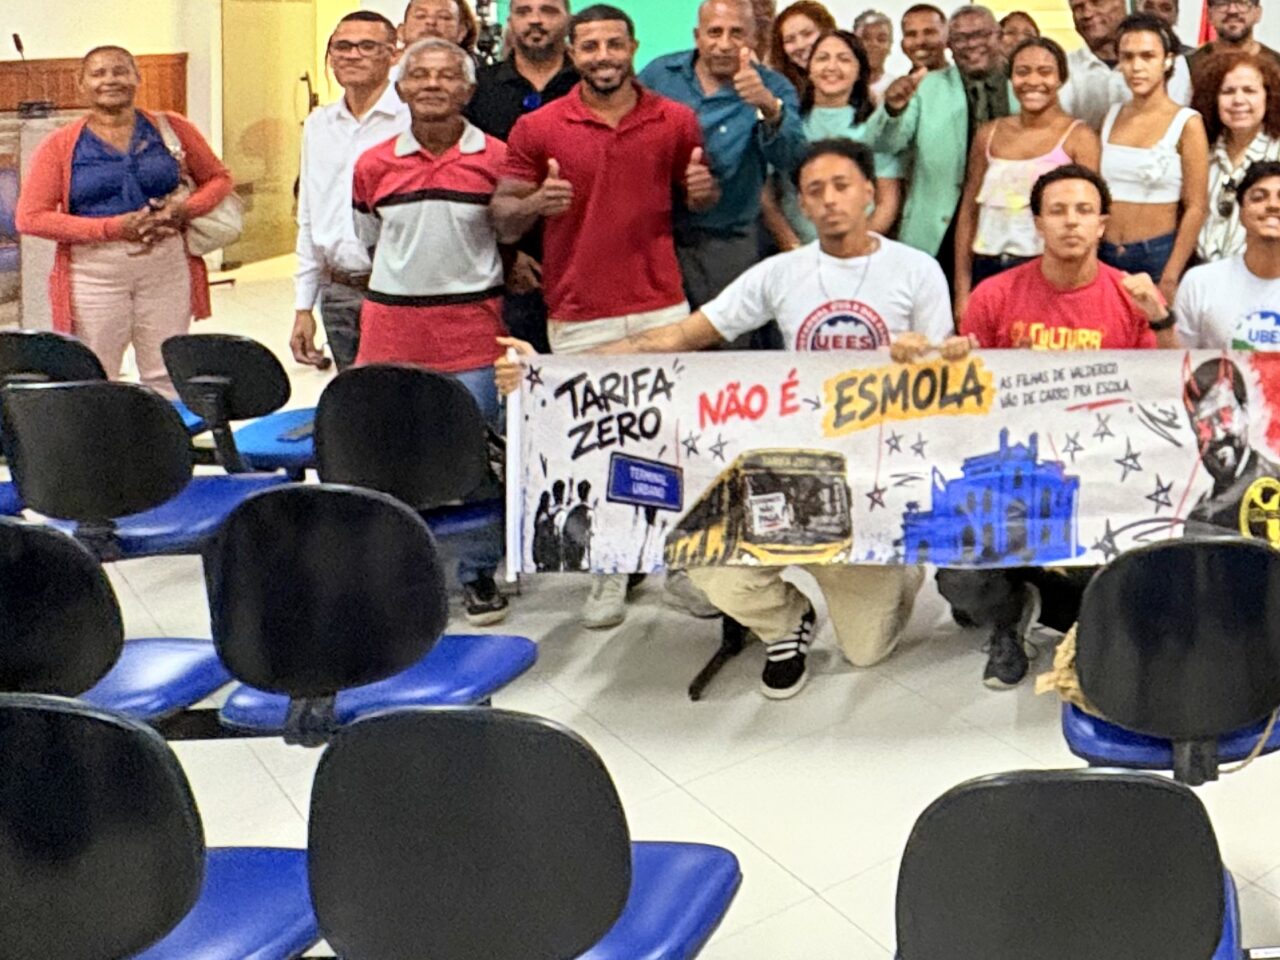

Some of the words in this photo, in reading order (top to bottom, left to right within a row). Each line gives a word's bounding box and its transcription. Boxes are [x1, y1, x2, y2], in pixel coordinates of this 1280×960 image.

[815, 335, 874, 350] UEES
[554, 368, 675, 419] TARIFA
[698, 381, 769, 430] NÃO
[779, 368, 800, 417] É
[832, 361, 986, 429] ESMOLA
[1000, 376, 1012, 389] AS
[1053, 368, 1065, 381] DE
[1000, 392, 1018, 409] VÃO
[1023, 391, 1036, 405] DE
[1096, 378, 1132, 396] ESCOLA
[568, 406, 662, 460] ZERO
